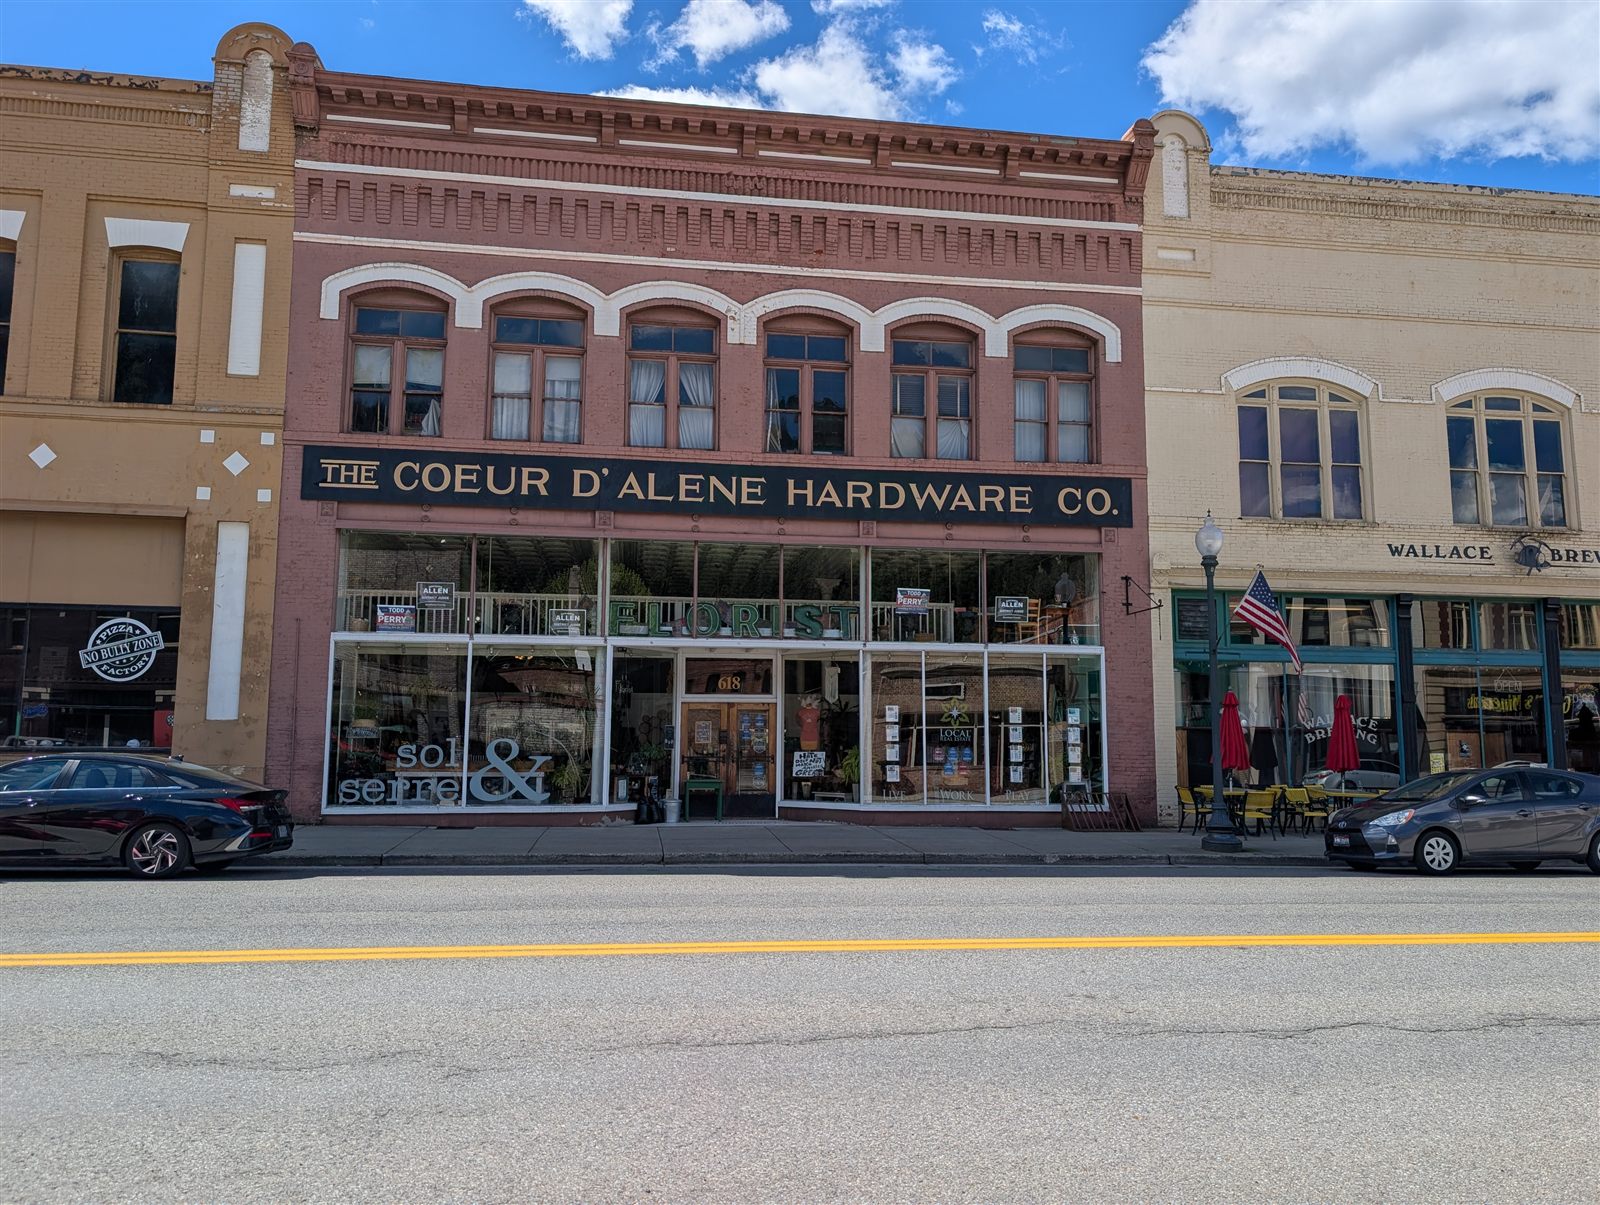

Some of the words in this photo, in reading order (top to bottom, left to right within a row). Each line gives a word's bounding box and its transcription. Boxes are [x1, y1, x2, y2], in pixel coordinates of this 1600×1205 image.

[320, 464, 379, 486] THE
[393, 461, 549, 497] COEUR
[571, 467, 768, 505] D'ALENE
[786, 478, 1034, 514] HARDWARE
[1057, 486, 1120, 517] CO.
[1386, 543, 1494, 560] WALLACE
[897, 597, 923, 606] PERRY
[377, 615, 407, 623] PERRY
[608, 600, 862, 640] FLORIST
[99, 624, 133, 641] PIZZA
[83, 651, 99, 664] NO
[100, 643, 131, 659] BULLY
[132, 636, 160, 652] ZONE
[100, 654, 150, 676] FACTORY
[718, 675, 741, 690] 618
[1495, 680, 1522, 692] OPEN
[939, 728, 972, 737] LOCAL
[396, 737, 460, 769] sol
[339, 776, 460, 803] serre
[882, 788, 906, 801] LIVE
[939, 789, 976, 801] WORK
[1006, 789, 1032, 801] PLAY
